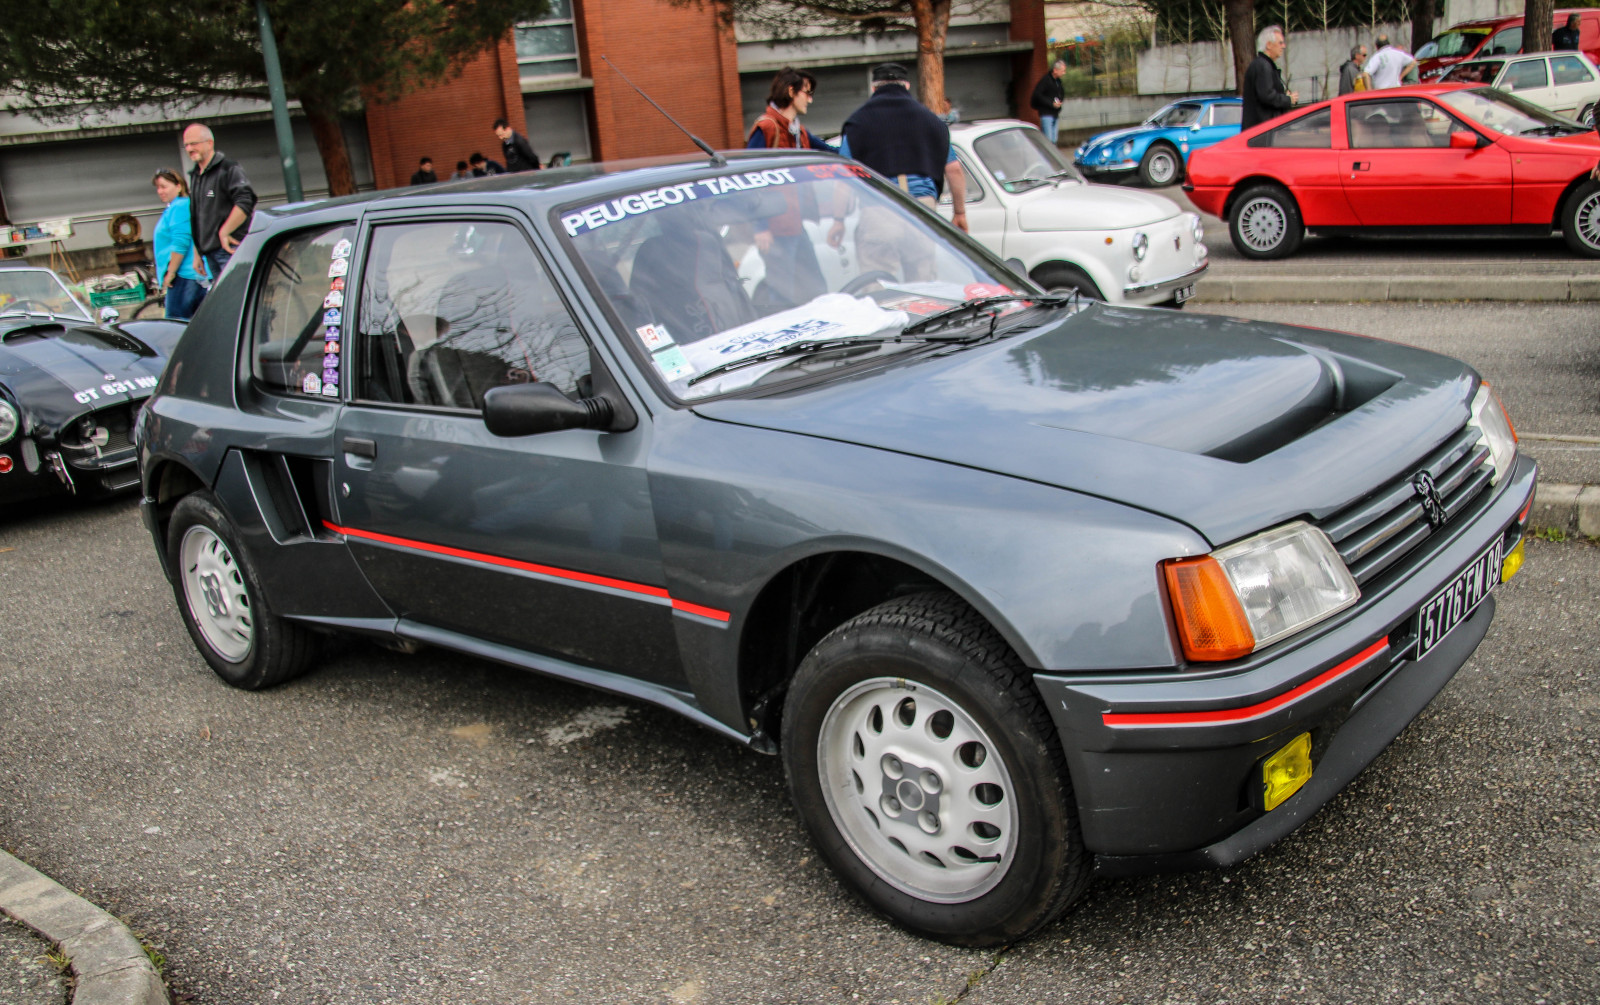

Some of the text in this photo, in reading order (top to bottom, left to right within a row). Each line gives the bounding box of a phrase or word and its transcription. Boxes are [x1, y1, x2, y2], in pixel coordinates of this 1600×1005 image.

[561, 182, 698, 237] PEUGEOT
[698, 168, 797, 195] TALBOT
[1424, 542, 1502, 650] 5776 FM 09
